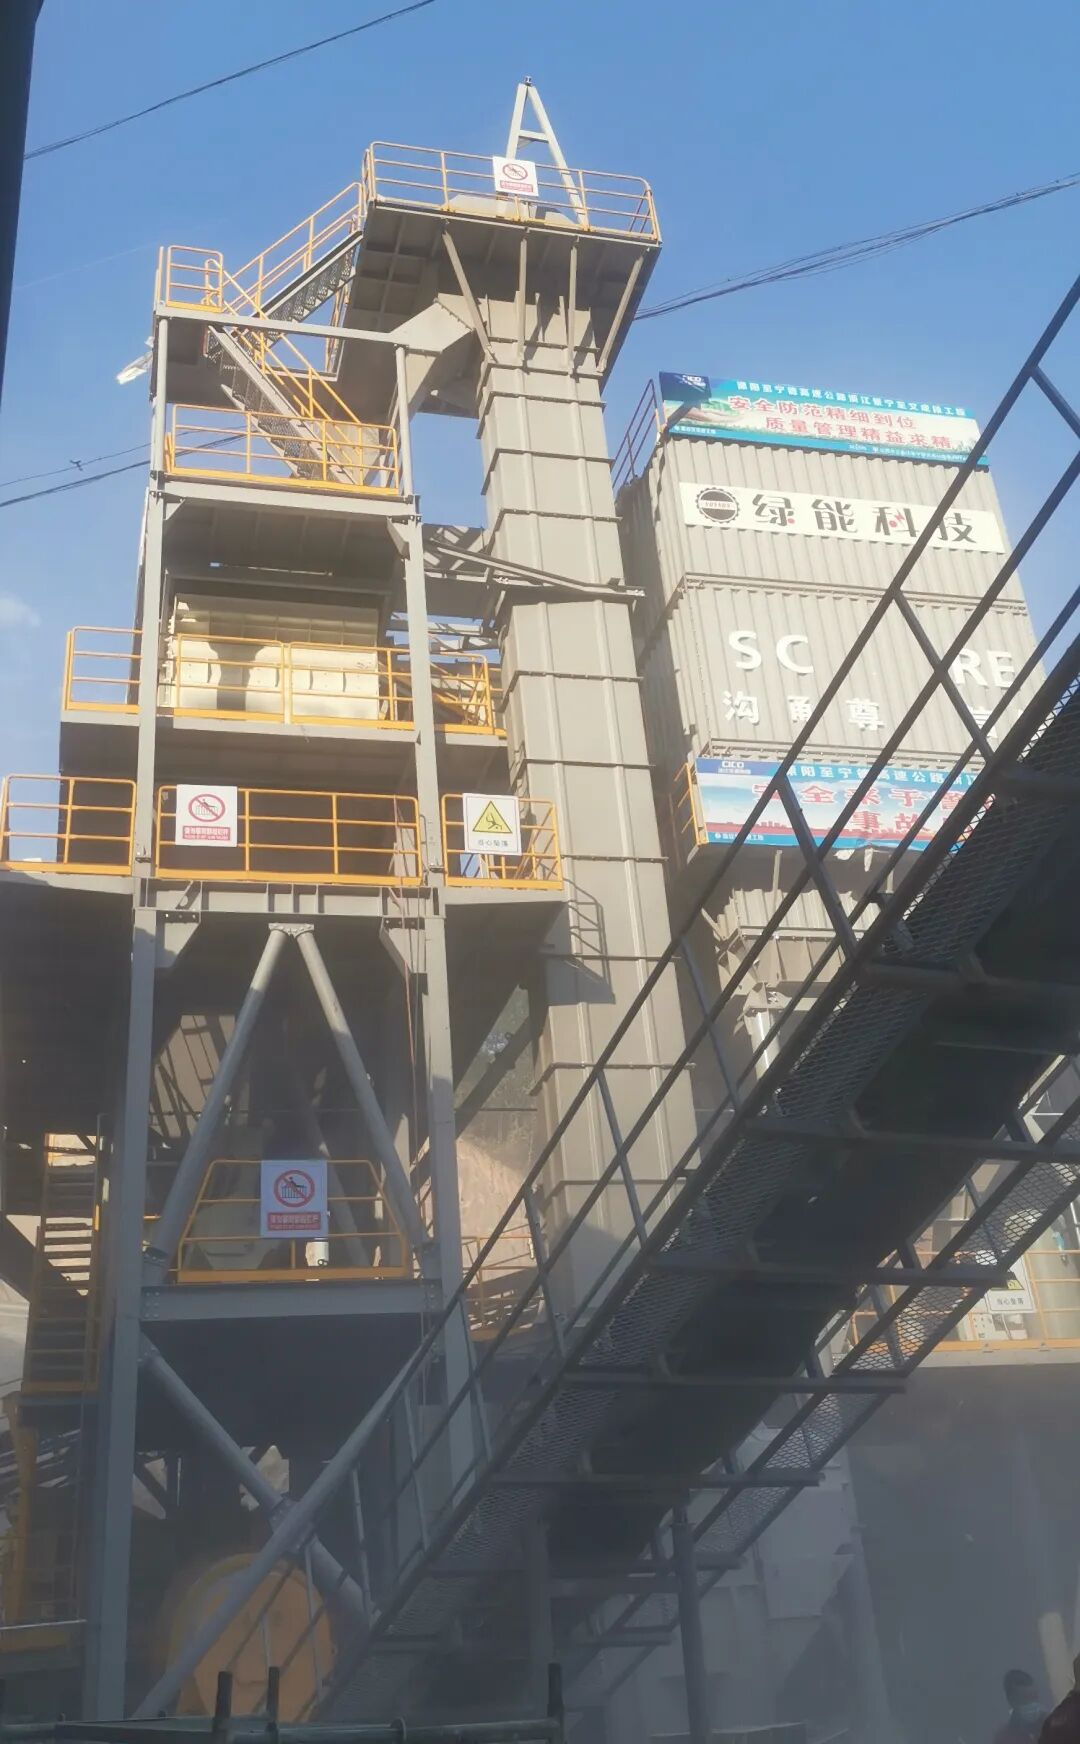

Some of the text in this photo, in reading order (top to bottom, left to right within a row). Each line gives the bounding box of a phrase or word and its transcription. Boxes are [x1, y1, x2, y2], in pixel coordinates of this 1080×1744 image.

[729, 395, 917, 429] 安全防范精细到位
[765, 416, 951, 449] 质量管理精益求精
[752, 493, 977, 543] 绿能科技
